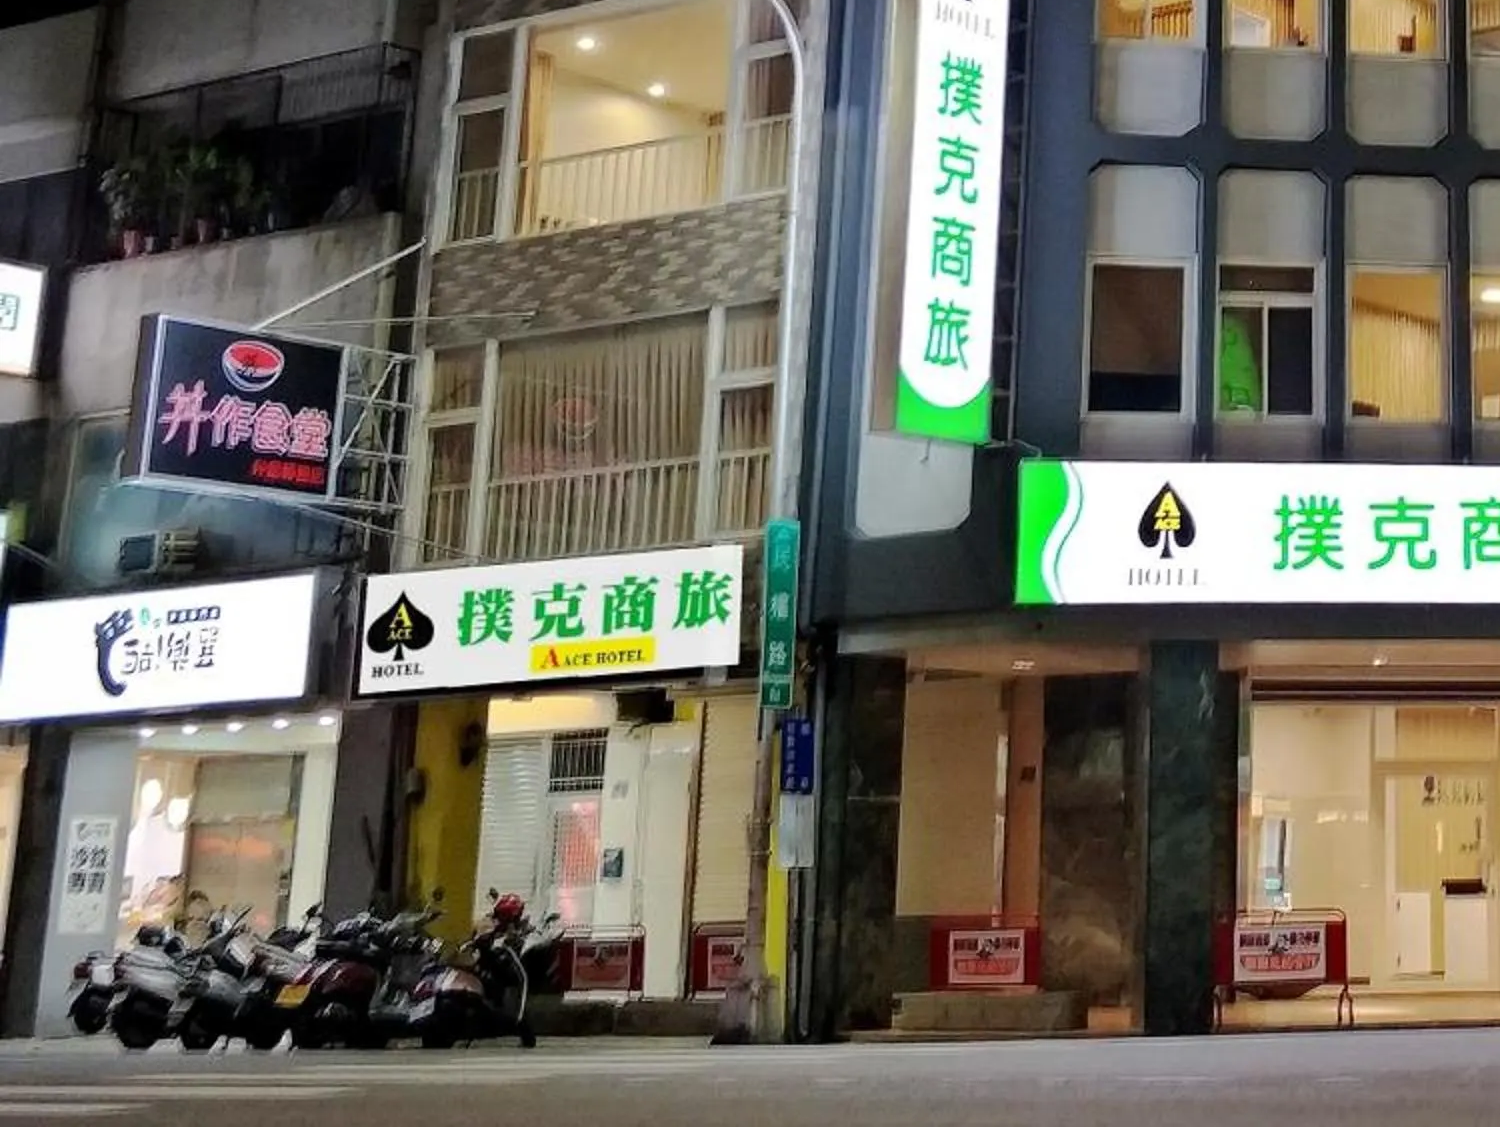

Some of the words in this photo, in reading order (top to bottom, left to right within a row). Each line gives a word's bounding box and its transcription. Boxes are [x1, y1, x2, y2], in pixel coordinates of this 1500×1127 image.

[924, 50, 984, 369] 撲克商旅
[389, 602, 413, 628] A
[455, 570, 735, 647] 撲克商旅
[387, 628, 413, 640] ACE
[371, 663, 424, 678] HOTEL
[540, 648, 562, 670] A
[564, 654, 592, 667] ACE
[596, 649, 646, 664] HOTEL
